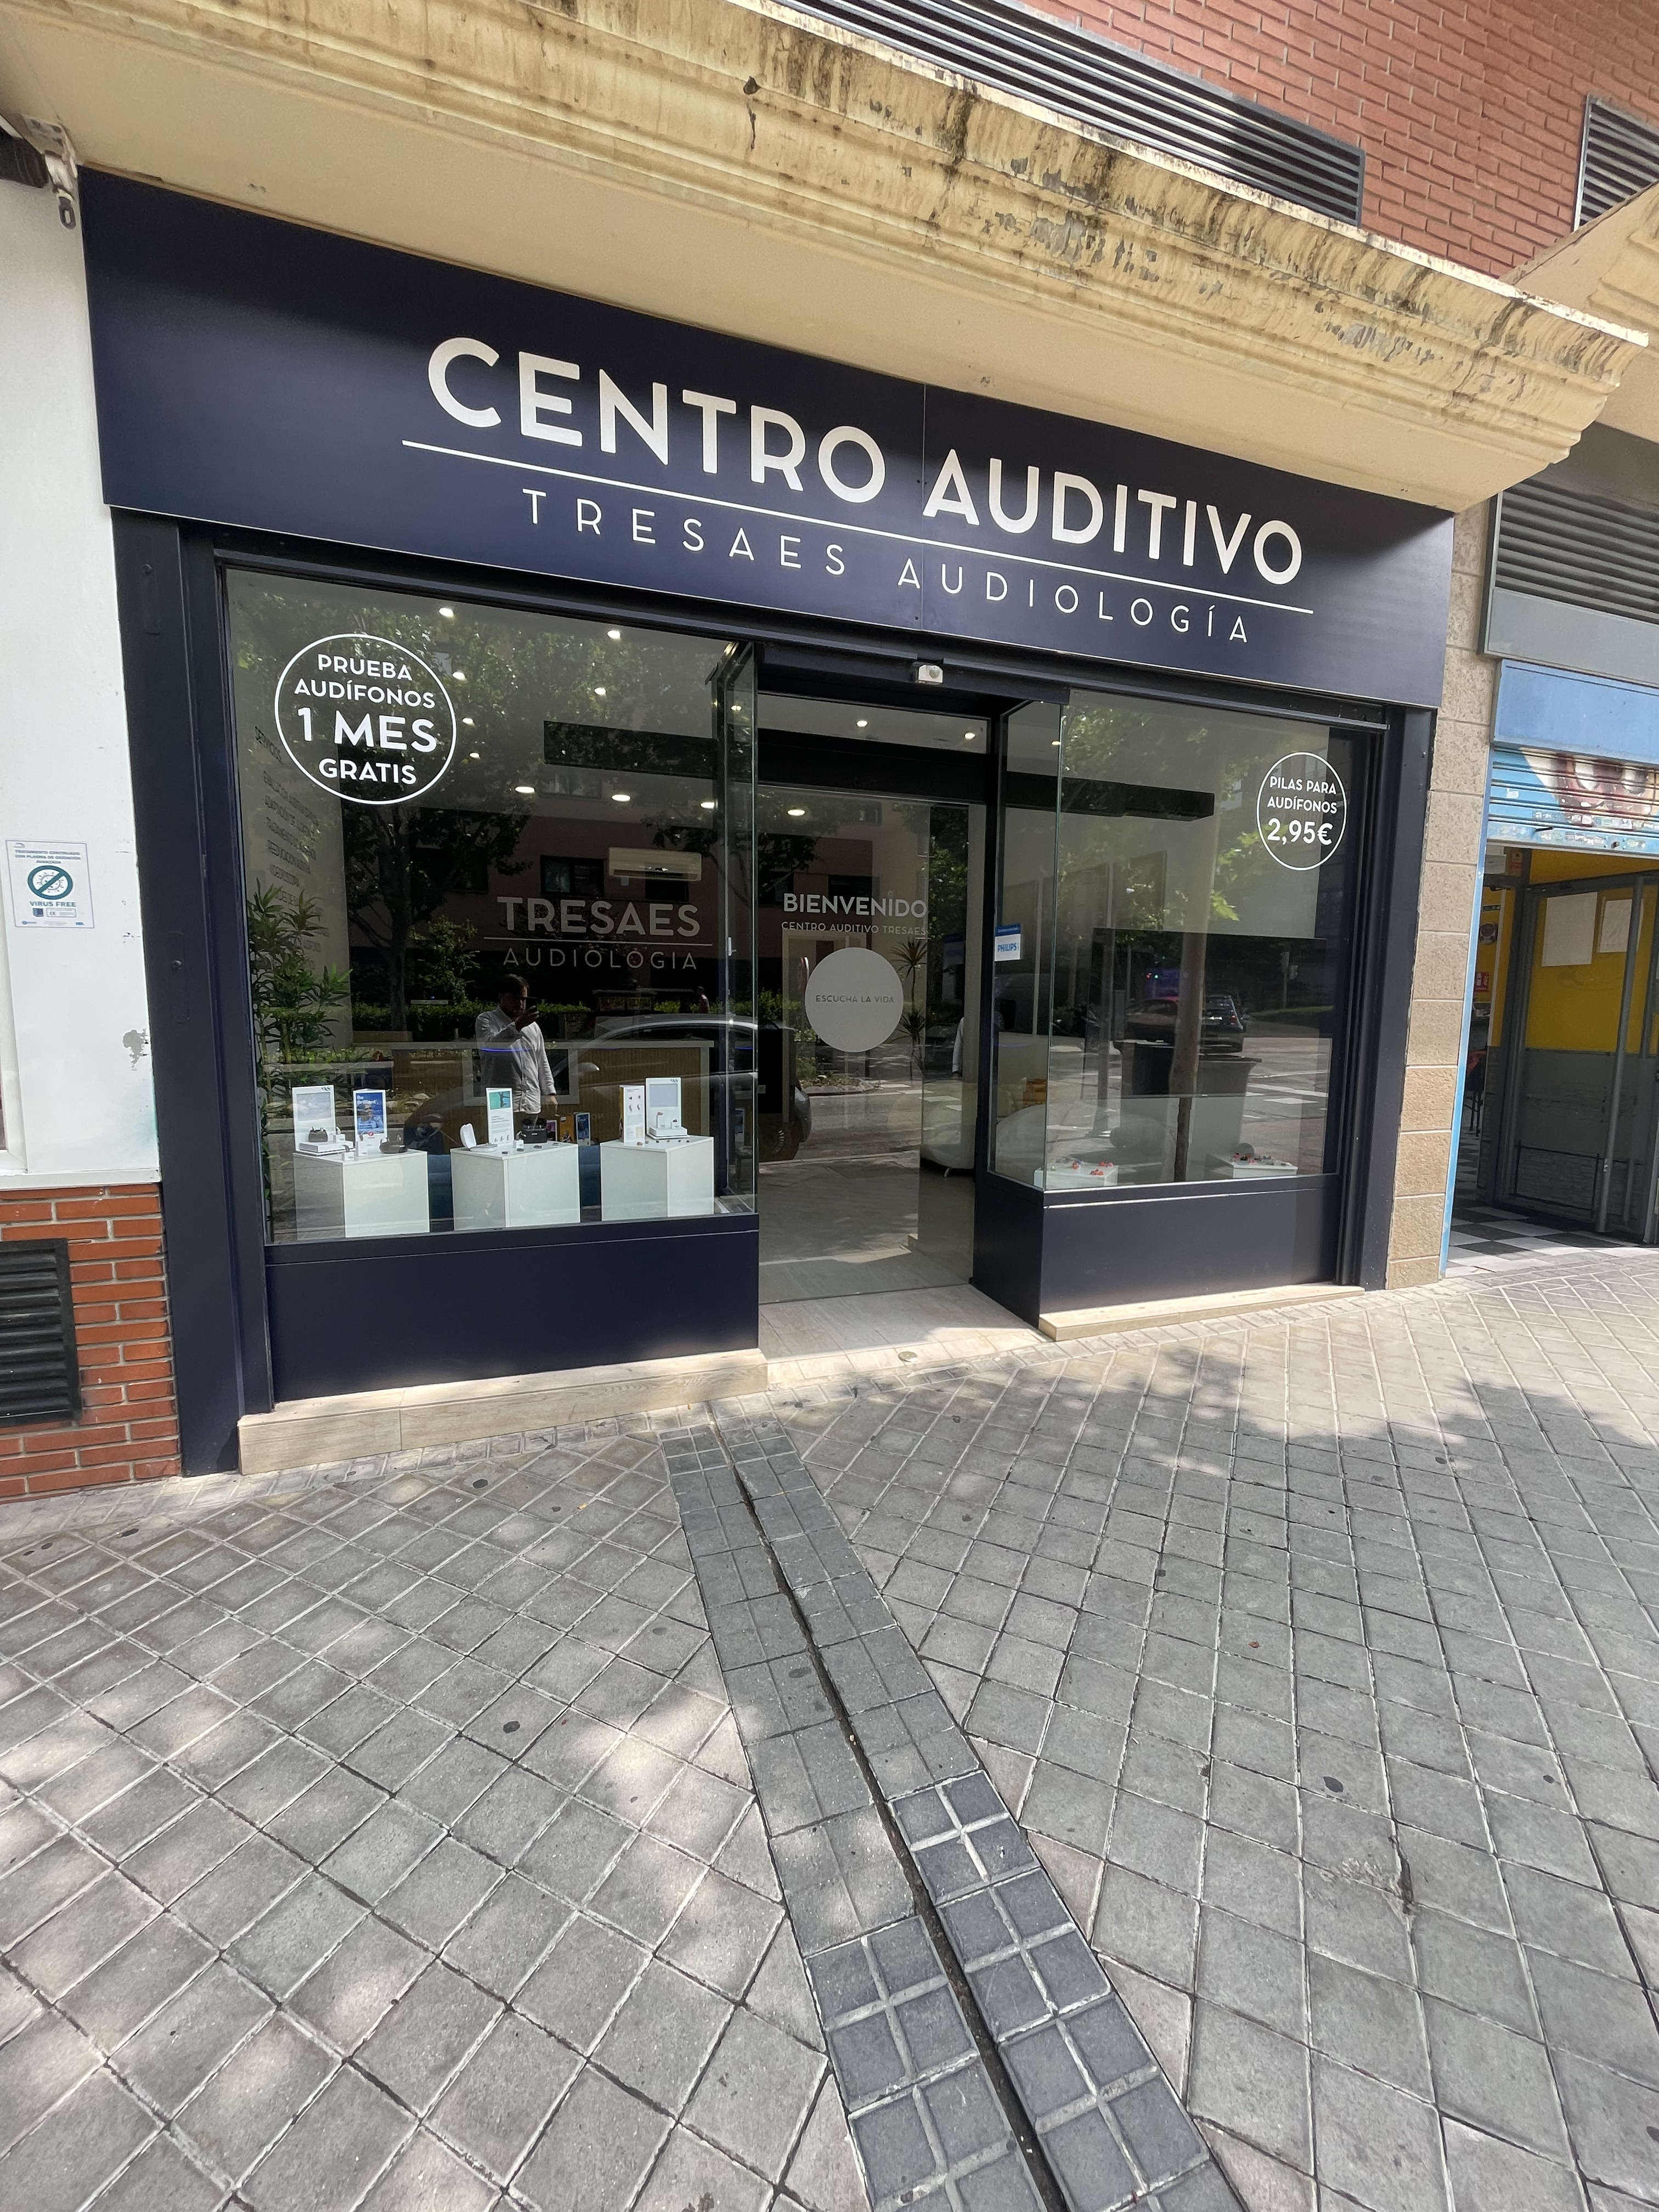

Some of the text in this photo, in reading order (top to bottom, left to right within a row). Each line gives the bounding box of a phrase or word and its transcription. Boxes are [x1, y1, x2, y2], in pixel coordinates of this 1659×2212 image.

[428, 337, 1302, 585] CENTRO AUDITIVO
[522, 488, 1248, 643] TRESAES AUDIOLOGÍA
[317, 653, 412, 681] PRUEBA
[294, 678, 436, 709] AUDÍFONOS
[297, 707, 437, 753] 1 MES
[318, 758, 417, 785] GRATIS
[1269, 776, 1337, 795] PILAS PARA
[1267, 795, 1338, 814] AUDÍFONOS
[1267, 817, 1333, 845] 2,95€
[497, 896, 700, 937] TRESAES
[783, 893, 927, 918] BIENVENIDO
[781, 921, 926, 935] CENTRO AUDITIVO TRESAES
[503, 947, 697, 970] AUDIOLOGIA
[997, 943, 1017, 952] PHILIPS
[815, 995, 857, 1003] ESCUCHA
